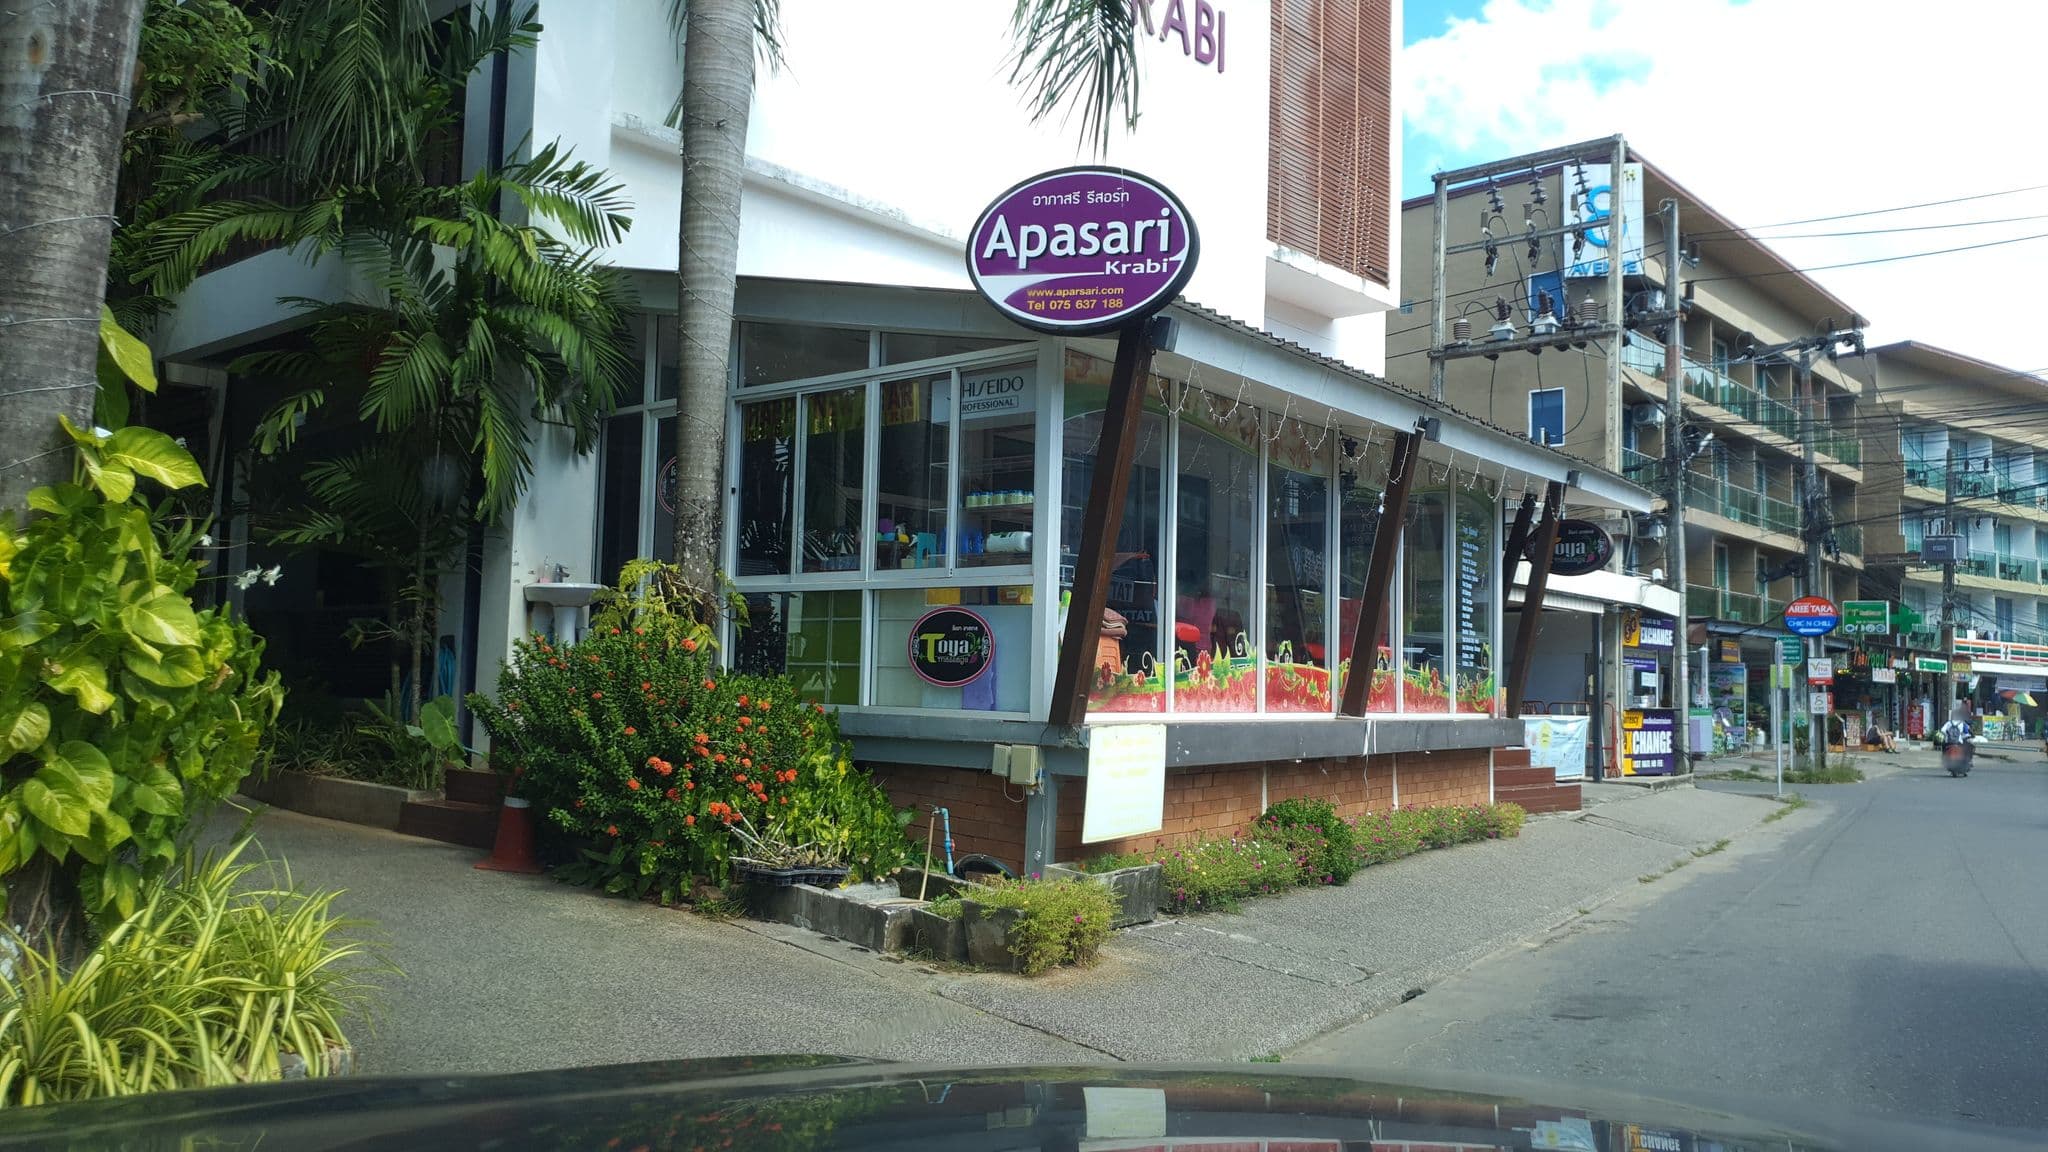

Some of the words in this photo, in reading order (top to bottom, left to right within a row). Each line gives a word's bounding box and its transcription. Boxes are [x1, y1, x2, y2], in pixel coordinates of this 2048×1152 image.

[982, 207, 1172, 270] Apasari
[1105, 259, 1168, 275] Krabi
[1571, 260, 1638, 276] AVEE
[1027, 286, 1124, 298] www.aparsari.com
[1027, 301, 1045, 310] Tel
[1049, 300, 1071, 310] 075
[1075, 299, 1096, 310] 637
[1102, 298, 1123, 309] 188
[962, 376, 1024, 398] HISEIDO
[961, 397, 1014, 412] ROFESSIONAL
[1640, 626, 1673, 646] EXCHANGE
